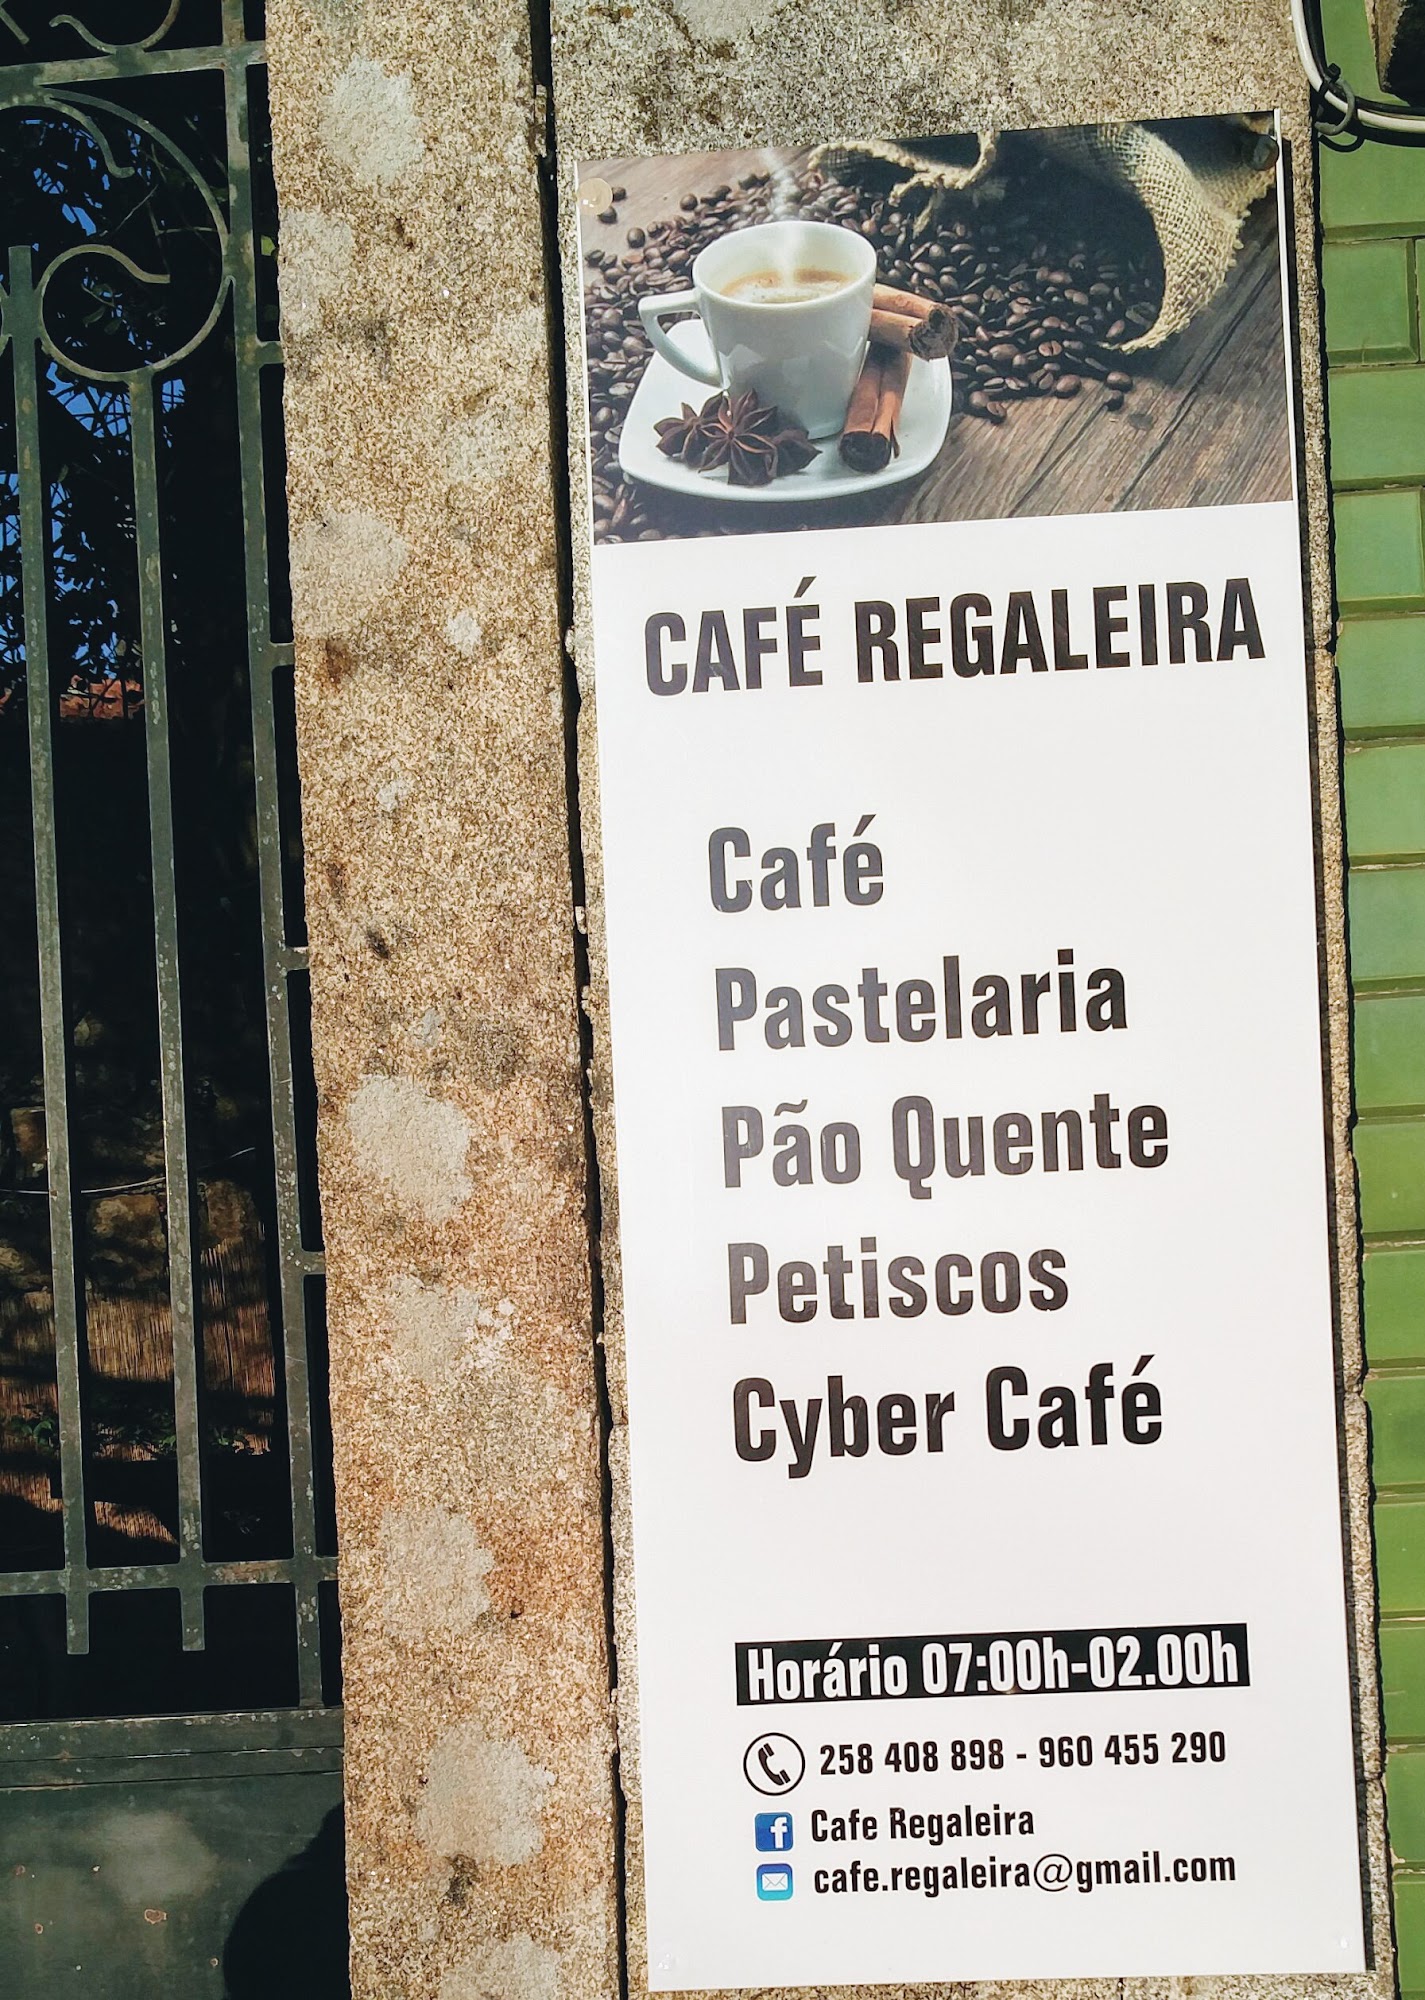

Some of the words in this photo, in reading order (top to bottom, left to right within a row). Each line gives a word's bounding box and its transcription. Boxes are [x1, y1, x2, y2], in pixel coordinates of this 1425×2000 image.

[644, 575, 824, 697] CAFÉ
[854, 577, 1266, 684] REGALEIRA
[708, 813, 884, 914] Café
[715, 948, 1128, 1051] Pastelaria
[721, 1099, 861, 1188] Pão
[891, 1093, 1169, 1200] Quente
[727, 1236, 1069, 1325] Petiscos
[733, 1374, 956, 1480] Cyber
[985, 1353, 1162, 1452] Café
[747, 1641, 908, 1701] Horário
[922, 1630, 1239, 1695] 07:00h-02.00h
[819, 1743, 874, 1776] 258
[884, 1740, 939, 1773] 408
[950, 1738, 1004, 1771] 898
[1038, 1735, 1093, 1768] 960
[1104, 1733, 1159, 1766] 455
[1170, 1730, 1226, 1764] 290
[811, 1808, 878, 1843] Cafe
[889, 1803, 1035, 1847] Regaleira
[814, 1850, 1236, 1898] cafe.regaleira@gmail.com
